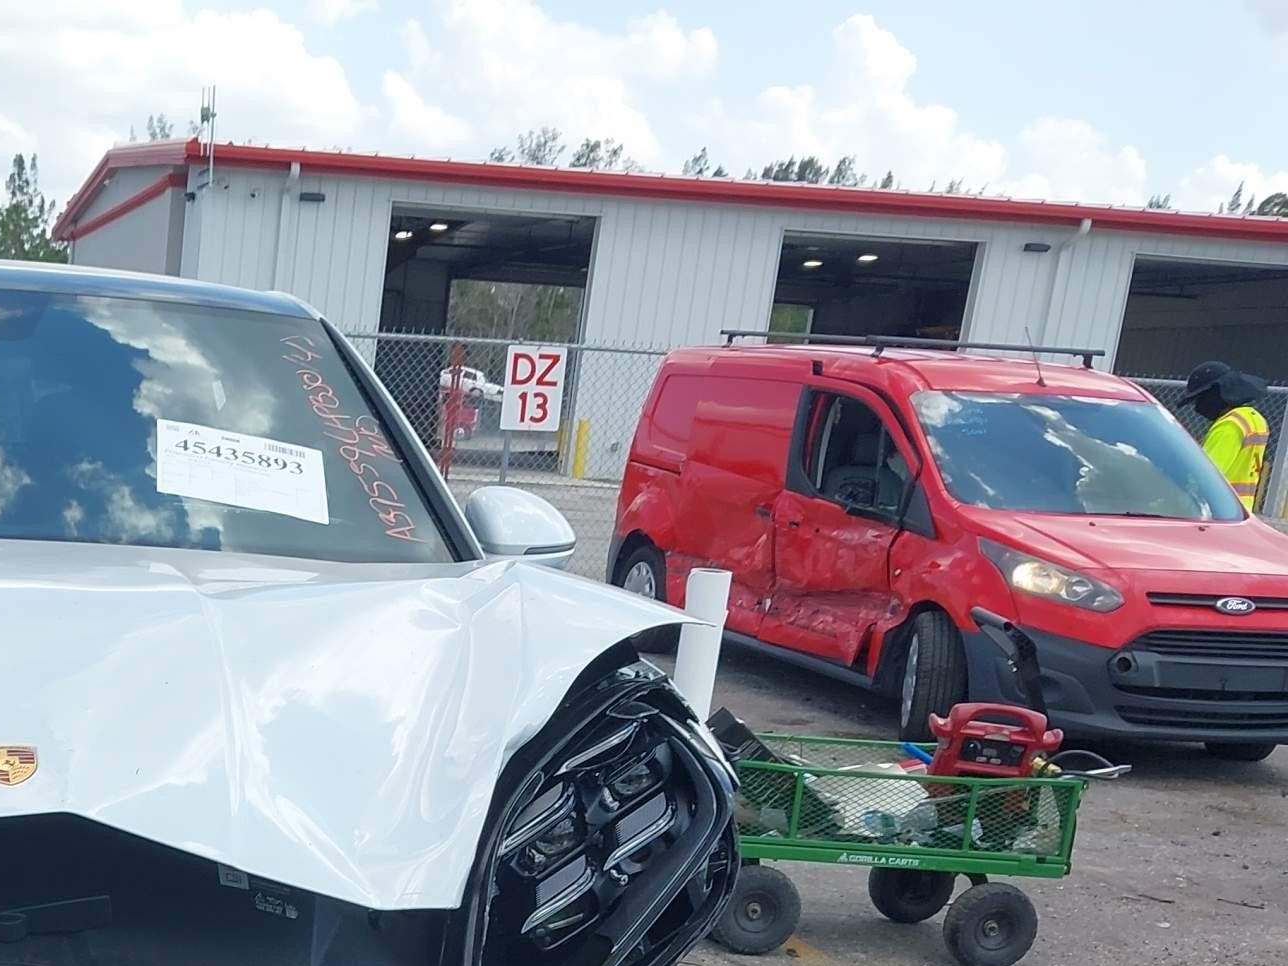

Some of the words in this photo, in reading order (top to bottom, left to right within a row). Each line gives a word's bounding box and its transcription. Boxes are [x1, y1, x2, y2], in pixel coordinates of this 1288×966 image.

[511, 352, 561, 387] DZ
[518, 391, 549, 423] 13
[175, 439, 304, 475] 45435893
[1226, 600, 1248, 610] Ford
